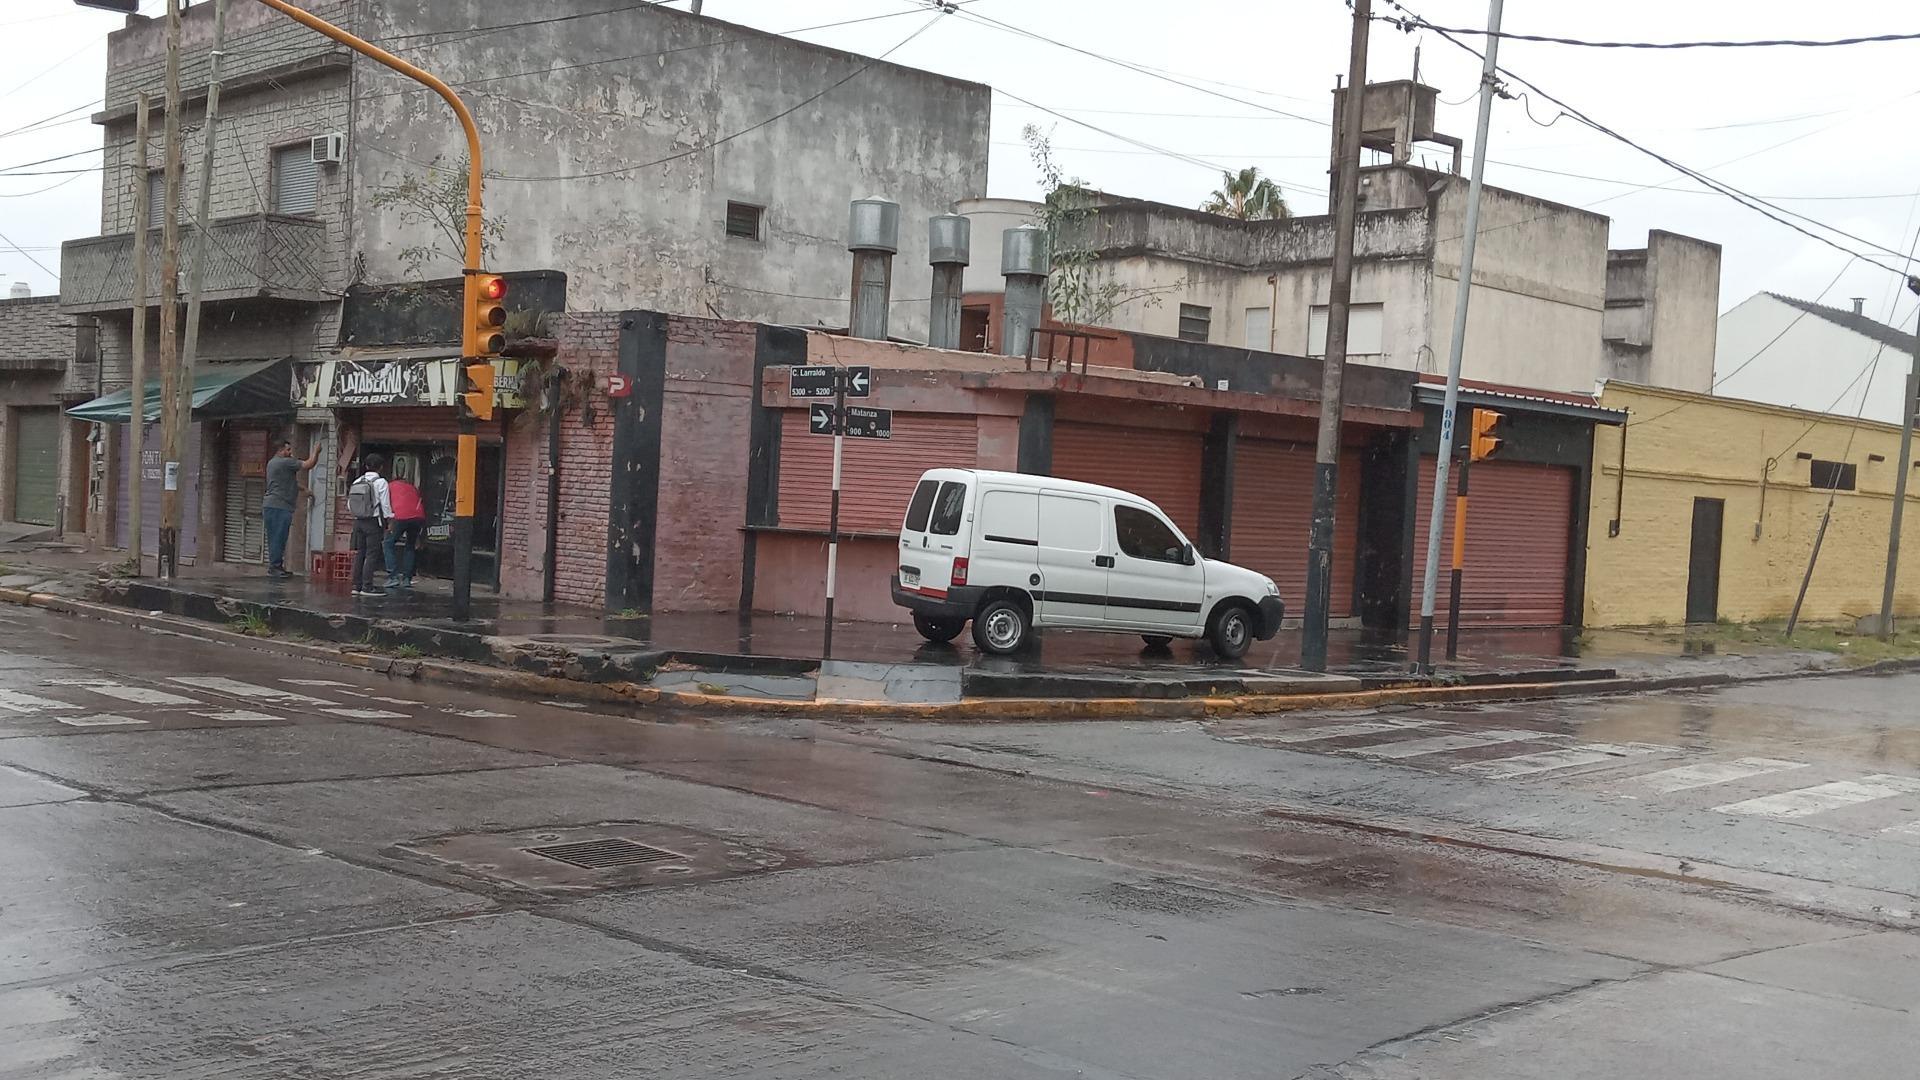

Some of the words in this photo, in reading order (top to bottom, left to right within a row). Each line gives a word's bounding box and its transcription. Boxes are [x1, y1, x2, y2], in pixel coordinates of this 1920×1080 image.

[800, 369, 826, 377] Larralde
[851, 409, 877, 418] Matanza
[1443, 410, 1451, 439] 904
